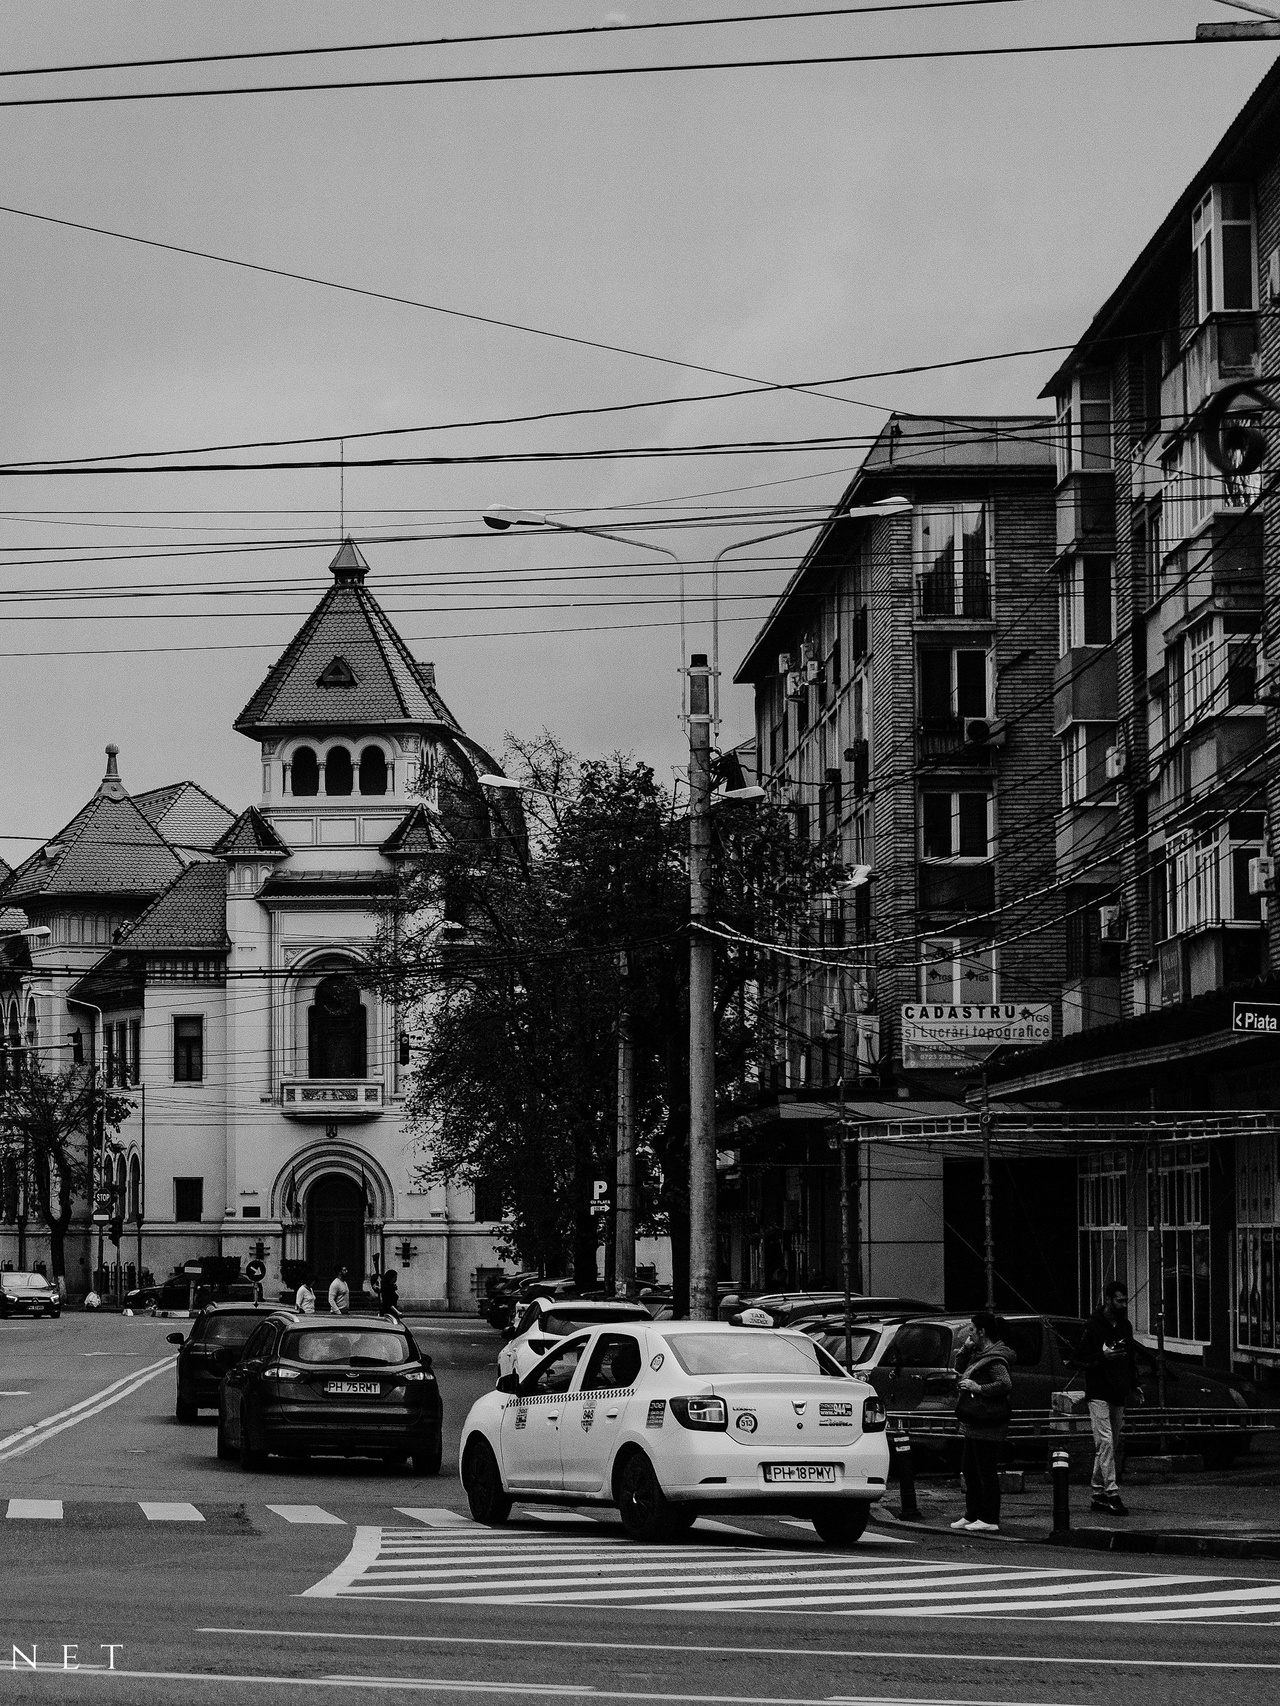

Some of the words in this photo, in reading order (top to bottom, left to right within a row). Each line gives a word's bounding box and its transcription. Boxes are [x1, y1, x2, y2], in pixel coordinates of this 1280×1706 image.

[904, 1006, 1016, 1019] CADASTRU
[1031, 1014, 1050, 1023] TGS
[1245, 1012, 1278, 1031] Piața
[973, 1025, 1050, 1041] topografice
[593, 1180, 608, 1200] P
[96, 1193, 111, 1202] STOP
[328, 1382, 343, 1392] PH
[773, 1467, 792, 1480] PH
